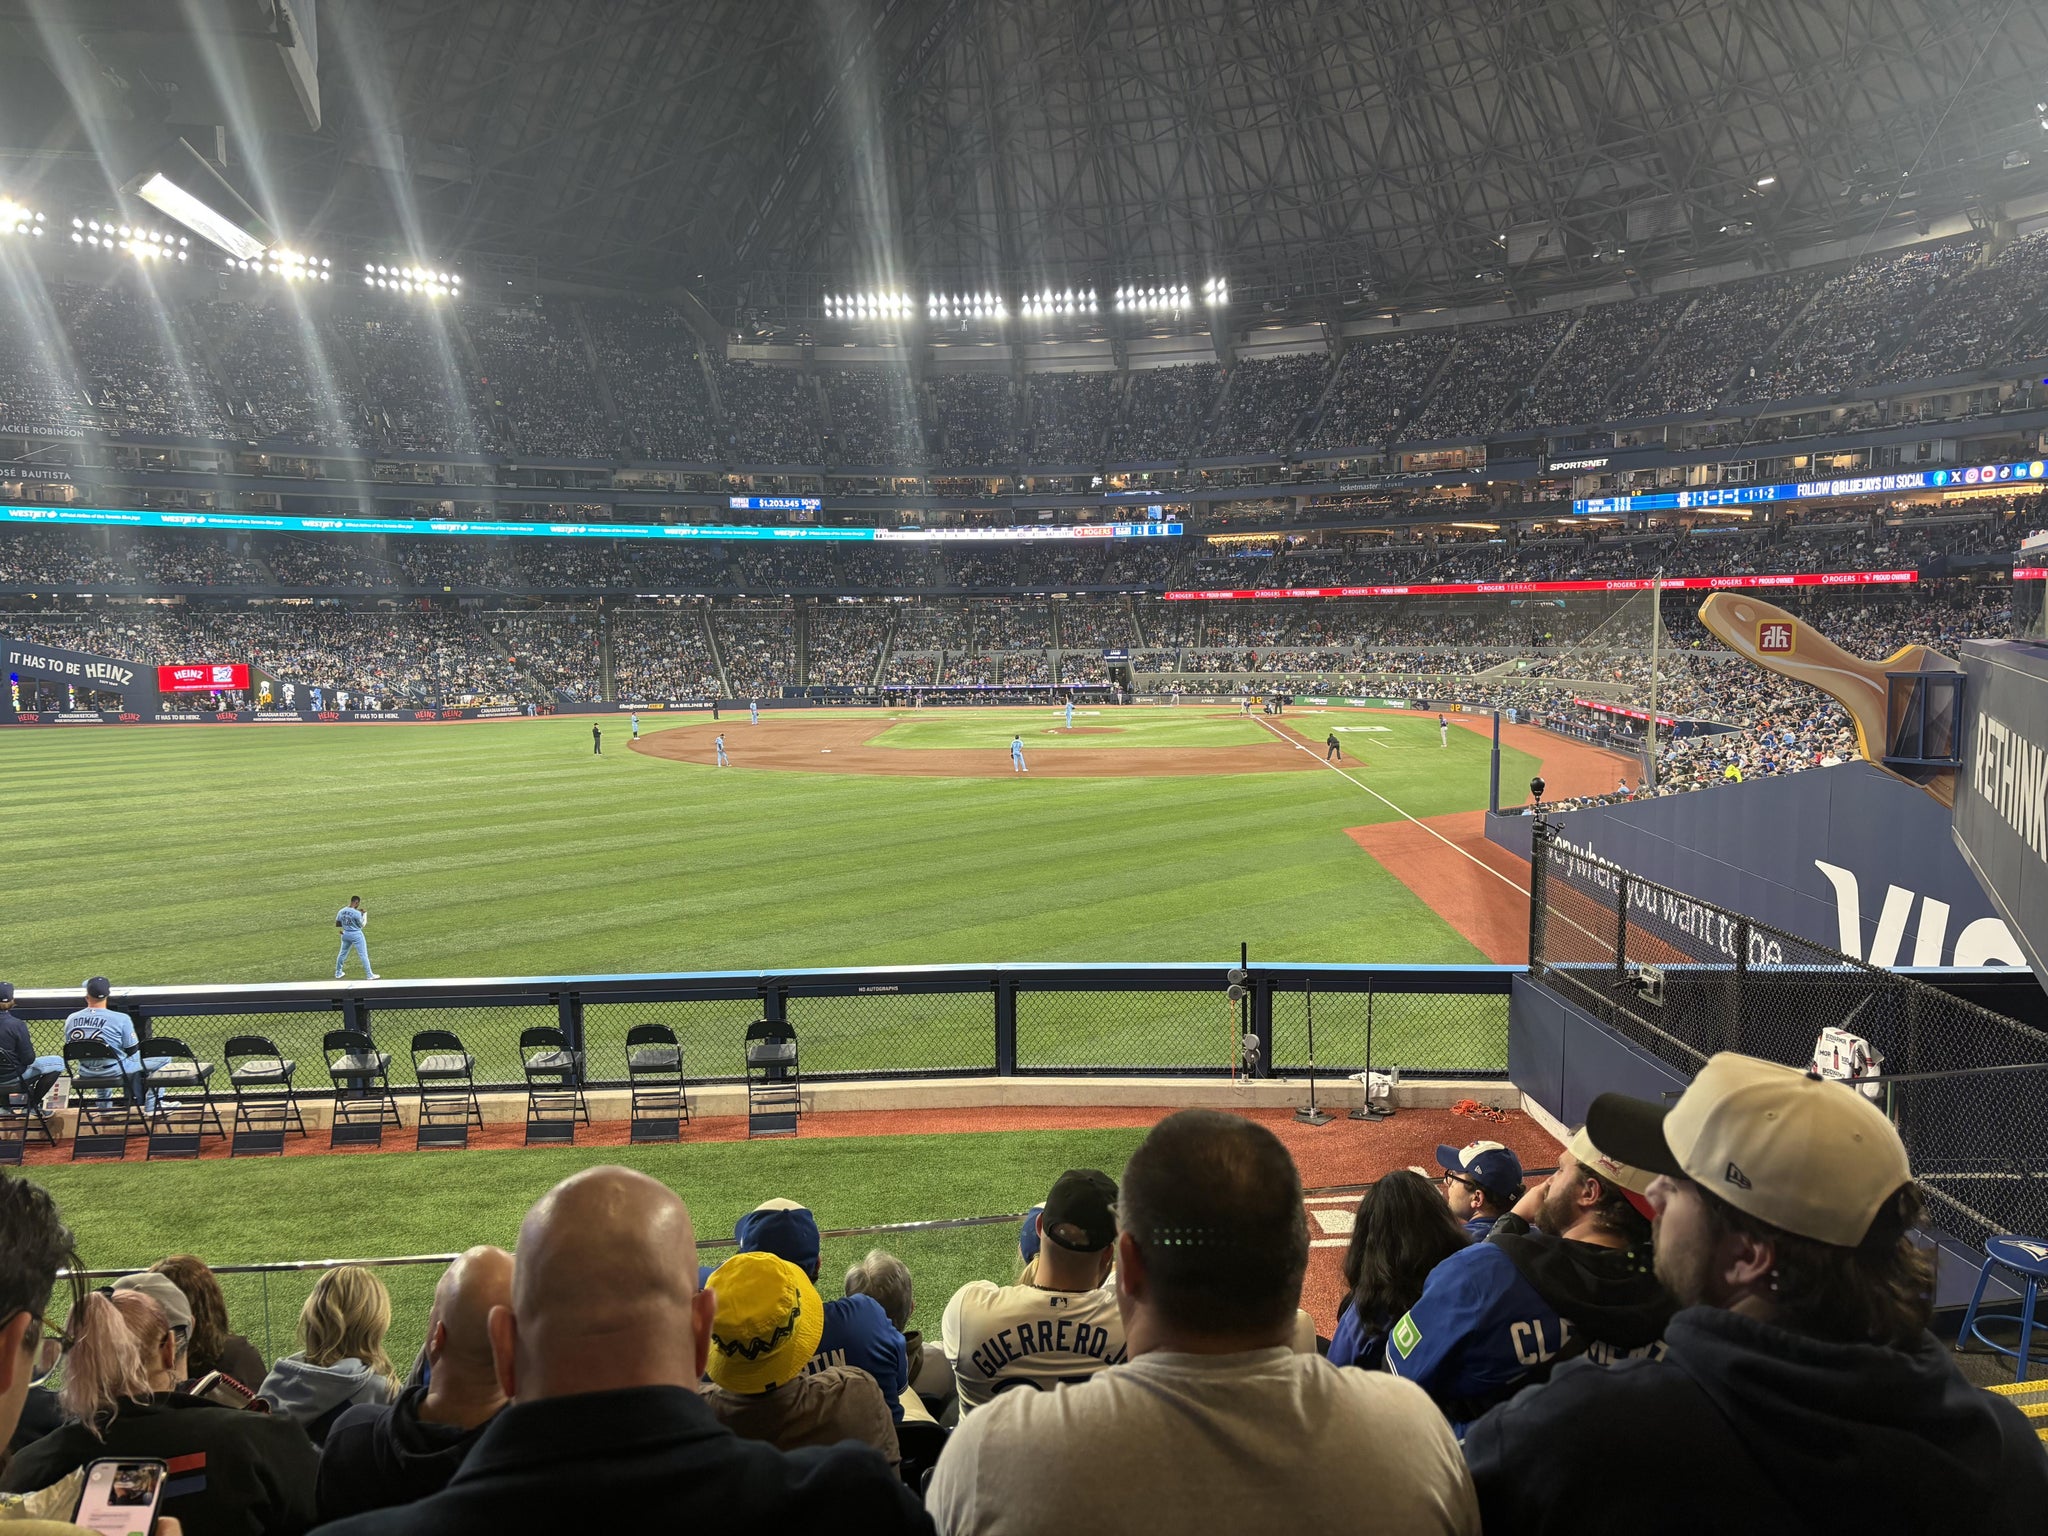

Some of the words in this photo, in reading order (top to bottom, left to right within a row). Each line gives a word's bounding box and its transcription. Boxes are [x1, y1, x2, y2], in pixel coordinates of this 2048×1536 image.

[32, 426, 84, 437] ROBINSON
[1550, 459, 1609, 471] SPORTSNET
[21, 470, 71, 480] BAUTISTA
[1340, 483, 1379, 492] ticketmaster
[1797, 482, 1831, 497] FOLLOW
[1831, 477, 1881, 495] @BLUEJAYS
[1882, 476, 1895, 489] ON
[1895, 473, 1926, 488] SOCIAL
[759, 498, 799, 507] $1,203,545
[9, 510, 47, 519] WESTJET
[1083, 527, 1112, 535] ROGERS
[9, 652, 21, 664] IT
[22, 654, 46, 669] HAS
[48, 659, 64, 672] TO
[66, 662, 81, 675] BE
[84, 663, 134, 685] HEINZ
[174, 669, 204, 679] HEINZ
[18, 713, 39, 722] HEINZ
[119, 712, 140, 721] HEINZ
[216, 712, 238, 721] HEINZ
[318, 711, 339, 720] HEINZ
[415, 709, 436, 719] HEINZ
[441, 710, 462, 719] HEINZ
[1974, 711, 2048, 864] RETHINK
[1625, 868, 1657, 915] you
[1662, 886, 1714, 945] want
[1748, 916, 1783, 964] be
[73, 1017, 107, 1028] DOMIAN
[971, 1319, 1109, 1379] GUERRERO
